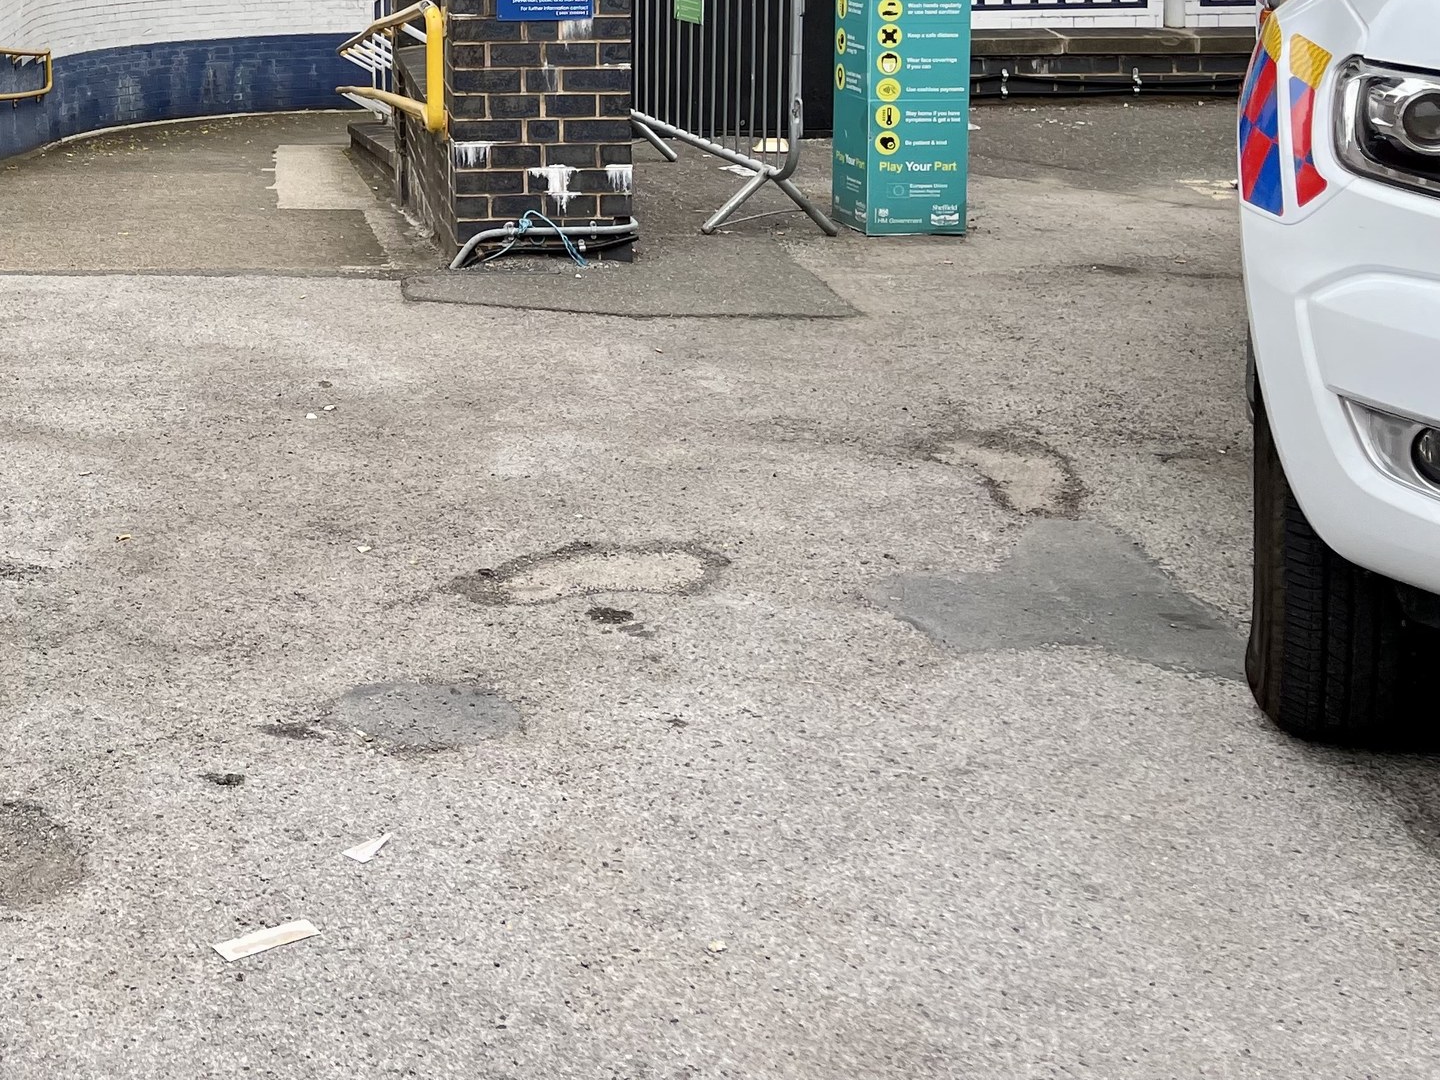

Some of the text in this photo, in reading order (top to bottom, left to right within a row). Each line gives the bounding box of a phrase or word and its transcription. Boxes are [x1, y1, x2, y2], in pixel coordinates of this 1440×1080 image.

[879, 161, 957, 173] Play Your Part
